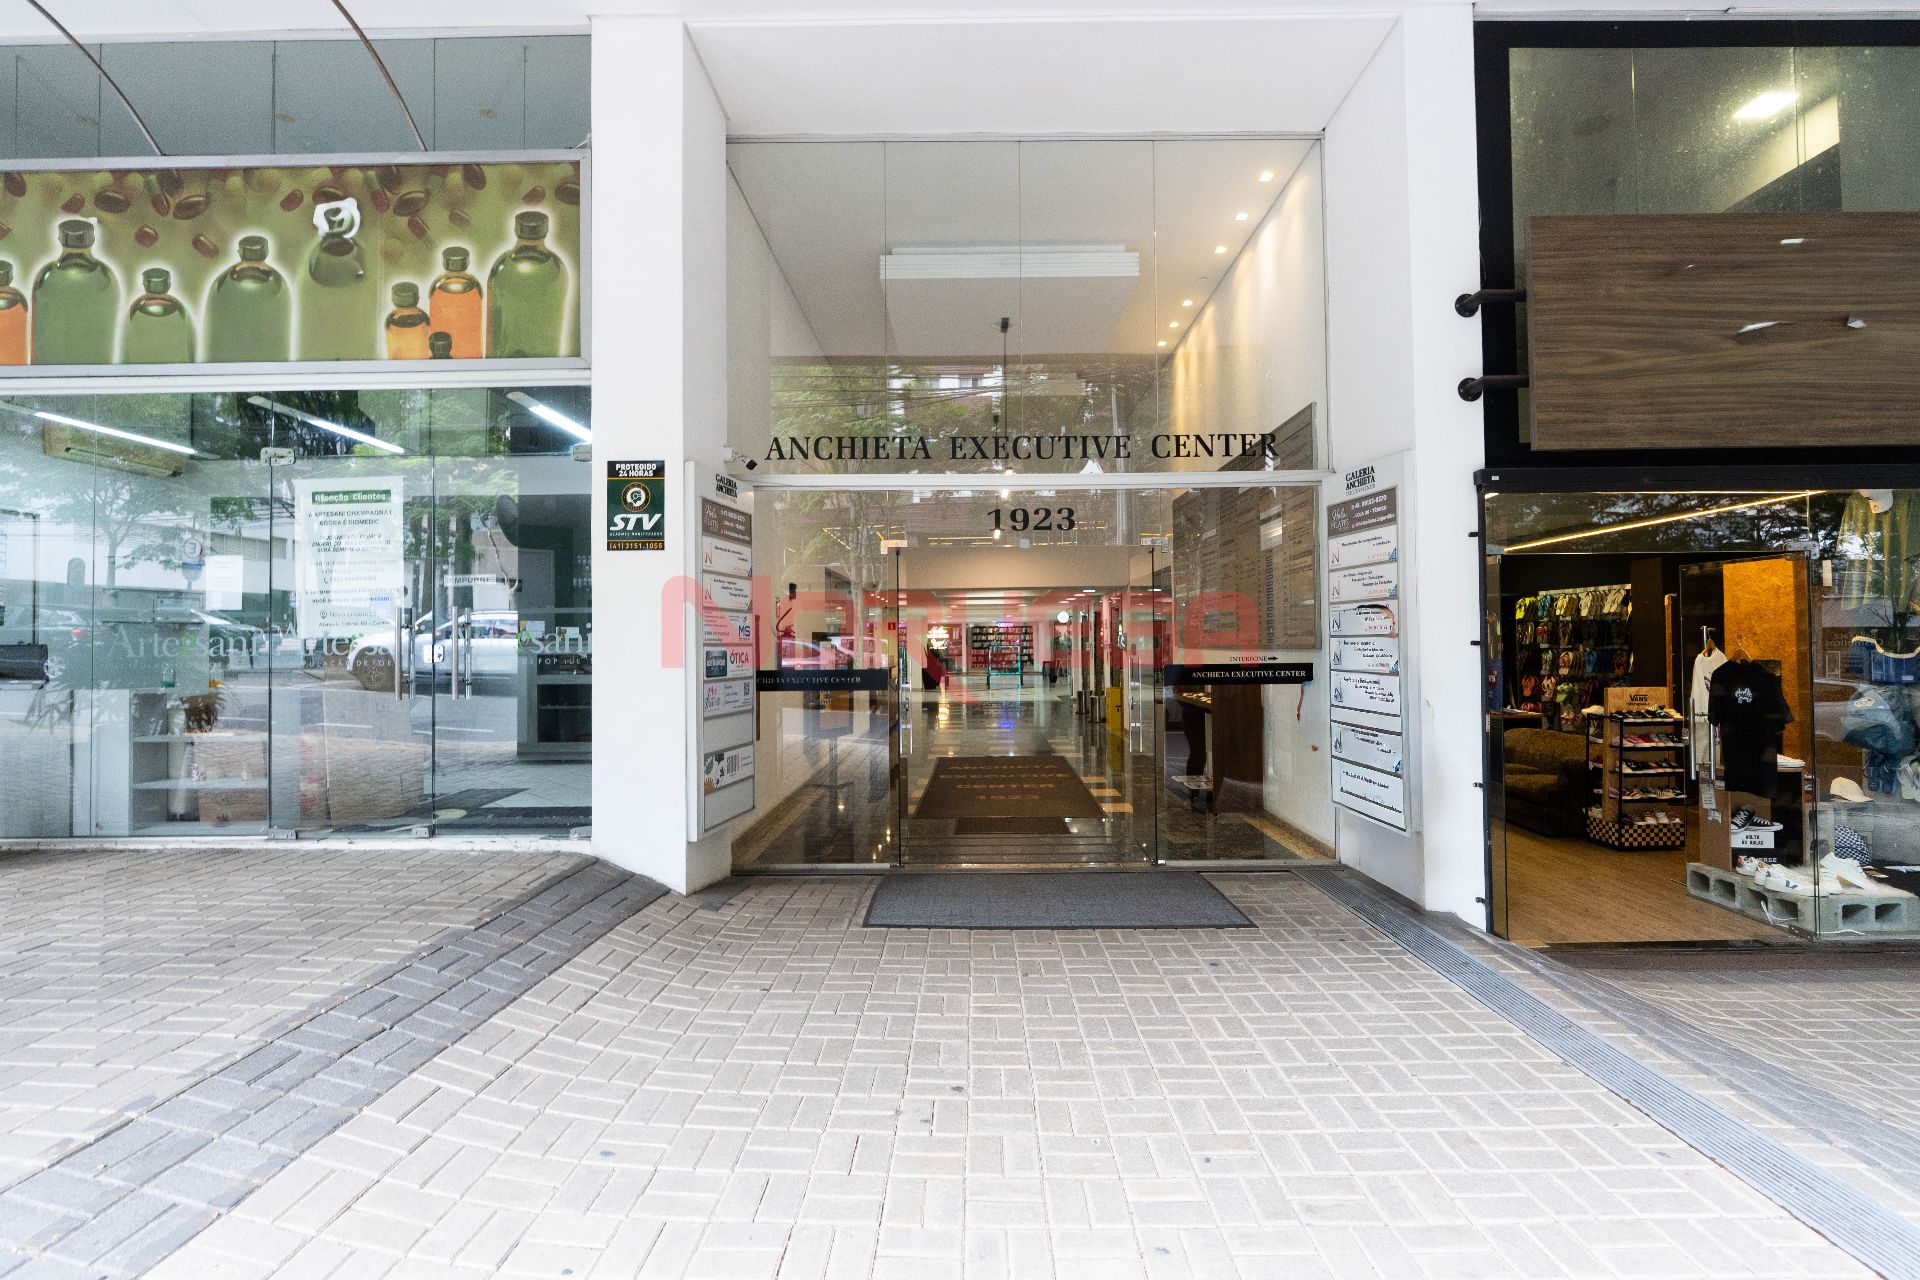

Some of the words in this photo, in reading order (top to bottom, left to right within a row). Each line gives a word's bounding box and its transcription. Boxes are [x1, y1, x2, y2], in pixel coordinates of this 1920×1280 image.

[765, 435, 931, 461] ANCHIETA
[950, 435, 1131, 461] EXECUTIVE
[1151, 432, 1279, 459] CENTER
[615, 463, 657, 471] PROTEGIDO
[1345, 465, 1375, 482] GALERIA
[715, 473, 738, 490] GALERIA
[1345, 474, 1376, 490] ANCHIETA
[314, 493, 349, 503] Atenção
[352, 492, 386, 501] Clientes
[609, 513, 663, 531] STV
[986, 506, 1077, 532] 1923
[738, 625, 751, 638] MS
[729, 649, 750, 665] ÓTICA
[756, 676, 785, 684] CHIETA
[1192, 671, 1230, 679] ANCHIETA
[1629, 694, 1649, 702] VANS
